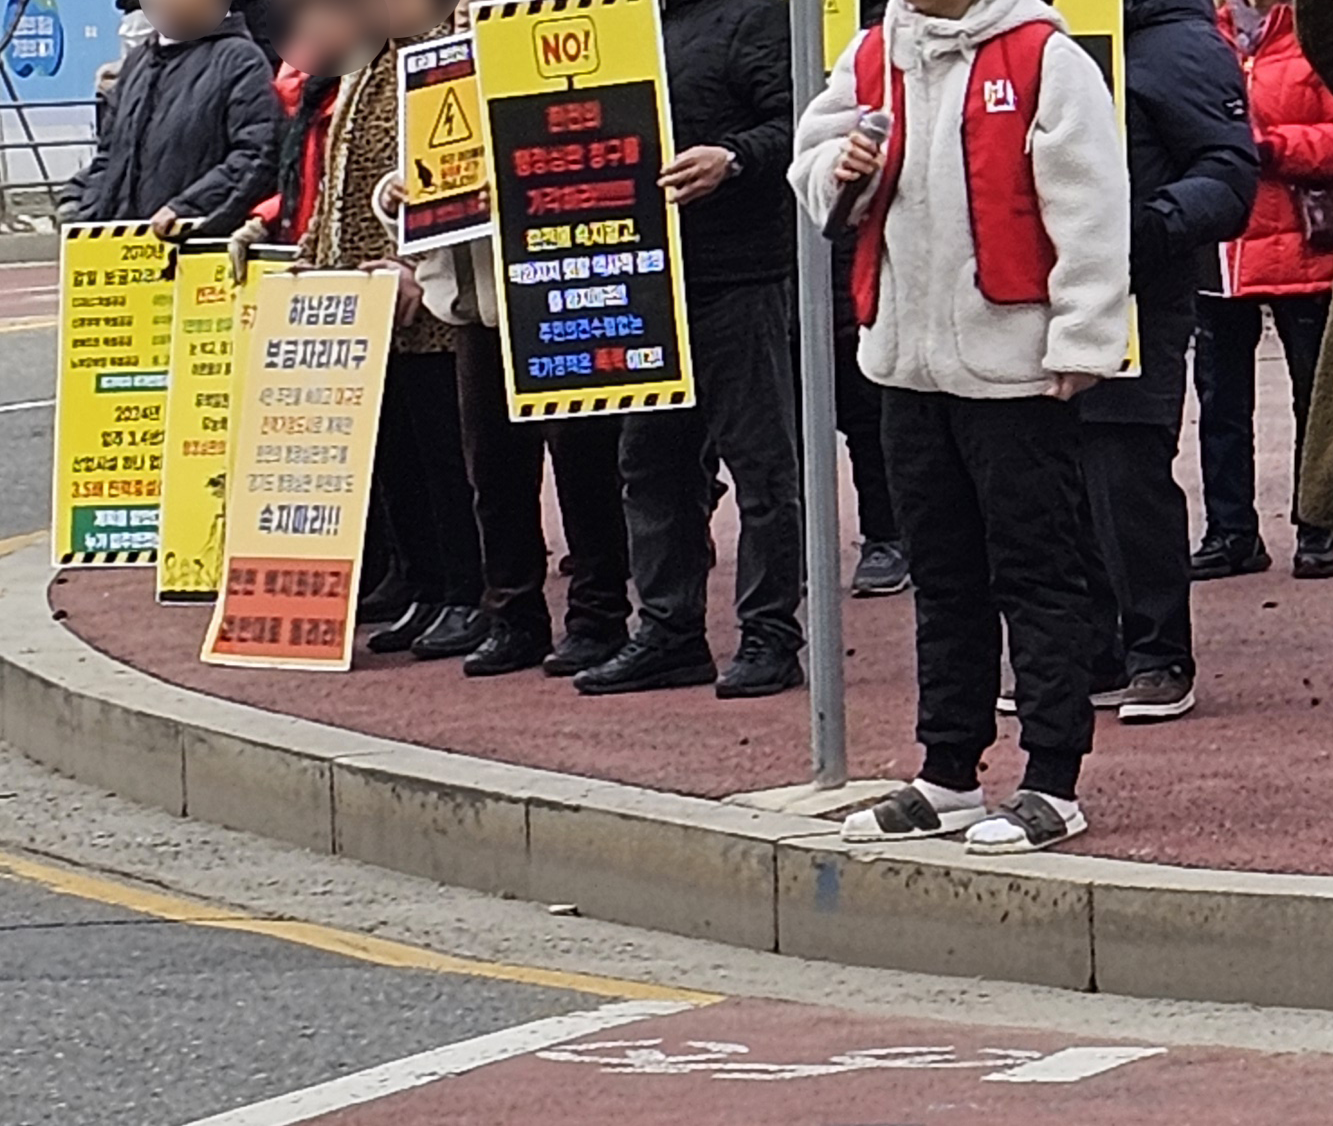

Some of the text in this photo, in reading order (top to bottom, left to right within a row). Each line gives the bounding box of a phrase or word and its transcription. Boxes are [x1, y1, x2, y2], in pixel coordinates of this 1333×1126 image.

[540, 29, 591, 66] NO!
[287, 293, 360, 326] 하남감일
[263, 337, 369, 370] 보금자리지구
[257, 503, 342, 536] 속지마라!!
